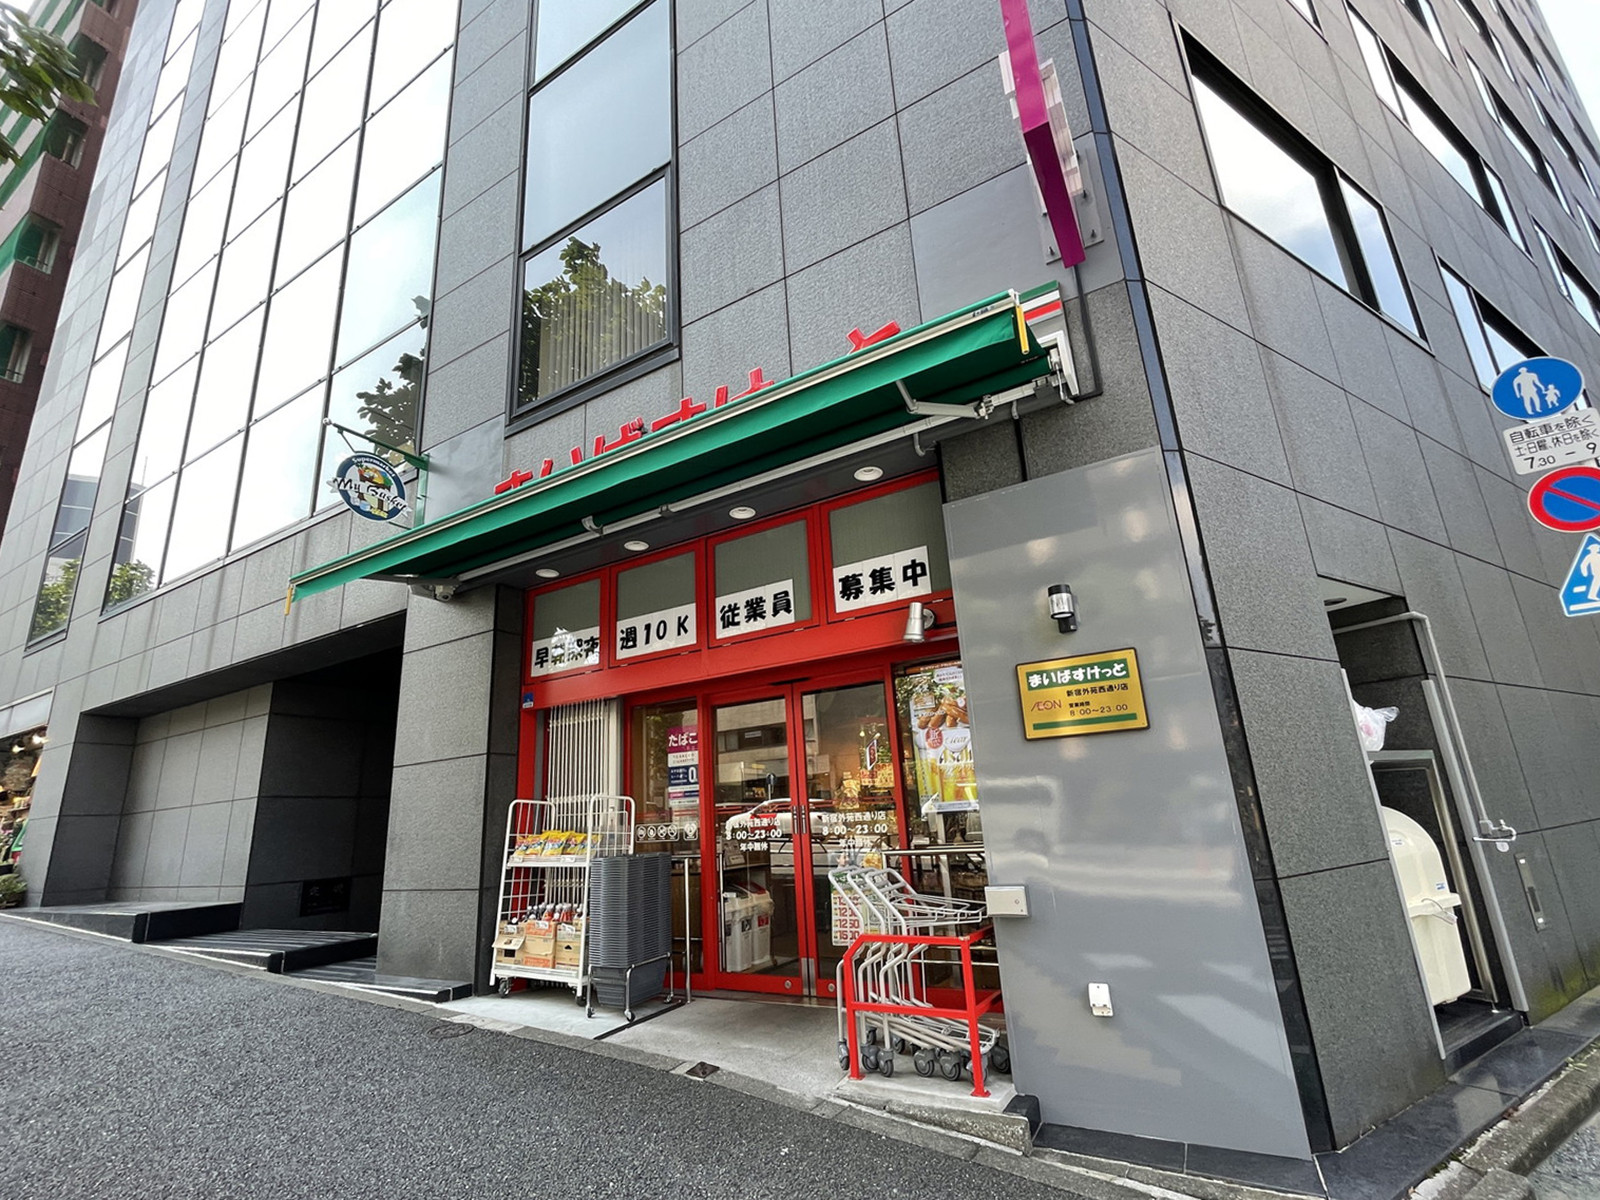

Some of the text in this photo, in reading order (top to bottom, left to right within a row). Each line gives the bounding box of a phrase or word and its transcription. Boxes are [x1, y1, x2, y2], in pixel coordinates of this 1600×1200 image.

[1510, 415, 1594, 443] 自転車を除く
[1586, 442, 1597, 455] 9
[352, 457, 395, 477] Supermarket
[333, 478, 407, 511] My Basket
[838, 559, 928, 601] 募集中
[720, 590, 792, 629] 従業員
[1028, 662, 1127, 688] まいばすけっと
[1066, 683, 1129, 697] 新宿外苑西通り店
[668, 732, 698, 747] たばこ
